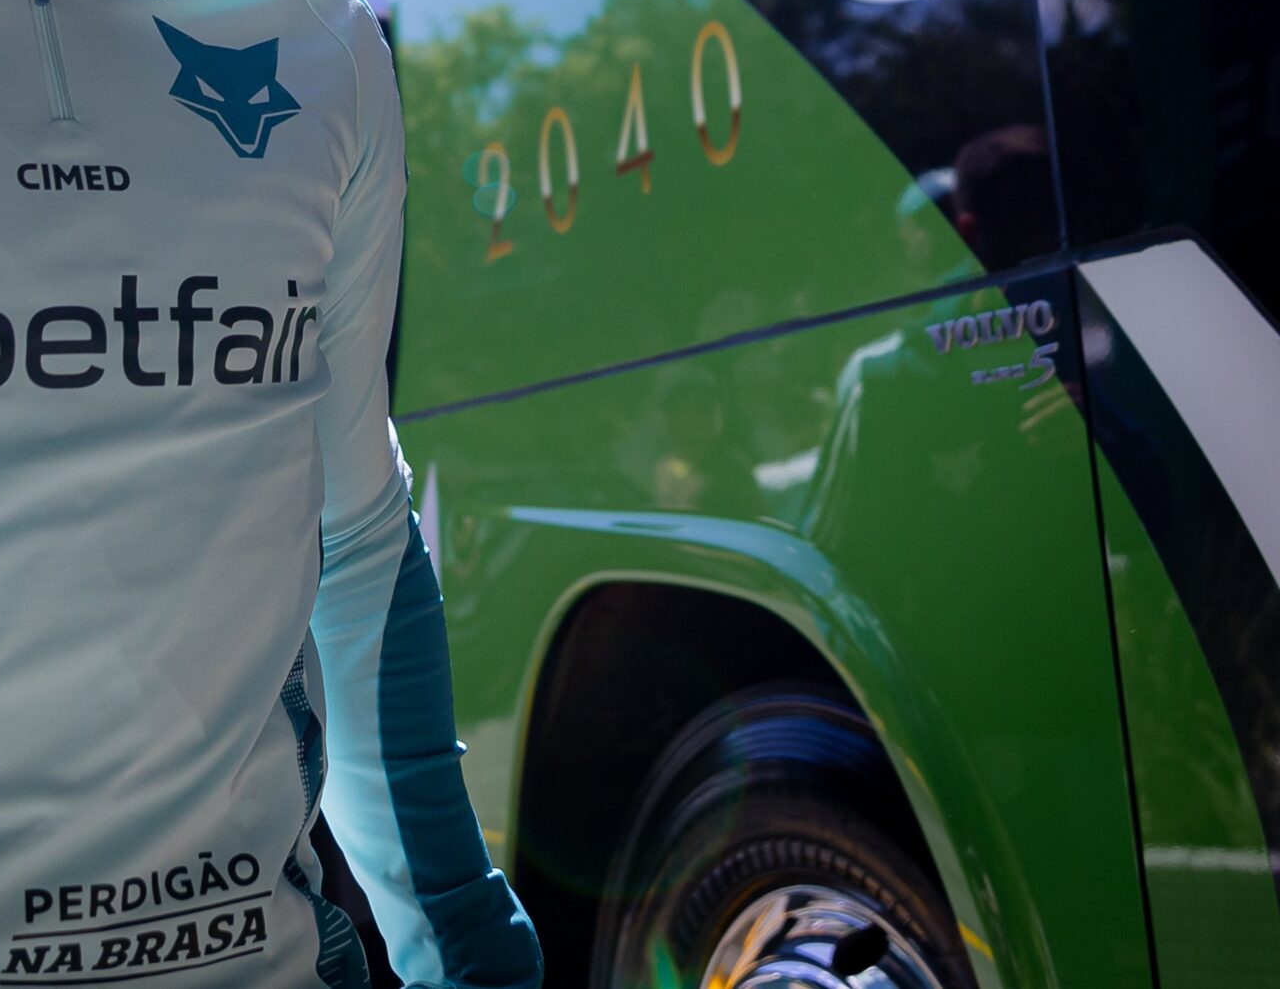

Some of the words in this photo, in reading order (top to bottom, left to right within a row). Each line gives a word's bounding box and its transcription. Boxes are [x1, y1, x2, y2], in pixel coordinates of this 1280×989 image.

[17, 163, 130, 192] CIMED
[926, 299, 1056, 355] VOLVO
[25, 851, 261, 924] PERDIGÃO
[1, 943, 84, 975] NA
[92, 907, 268, 971] BRASA
